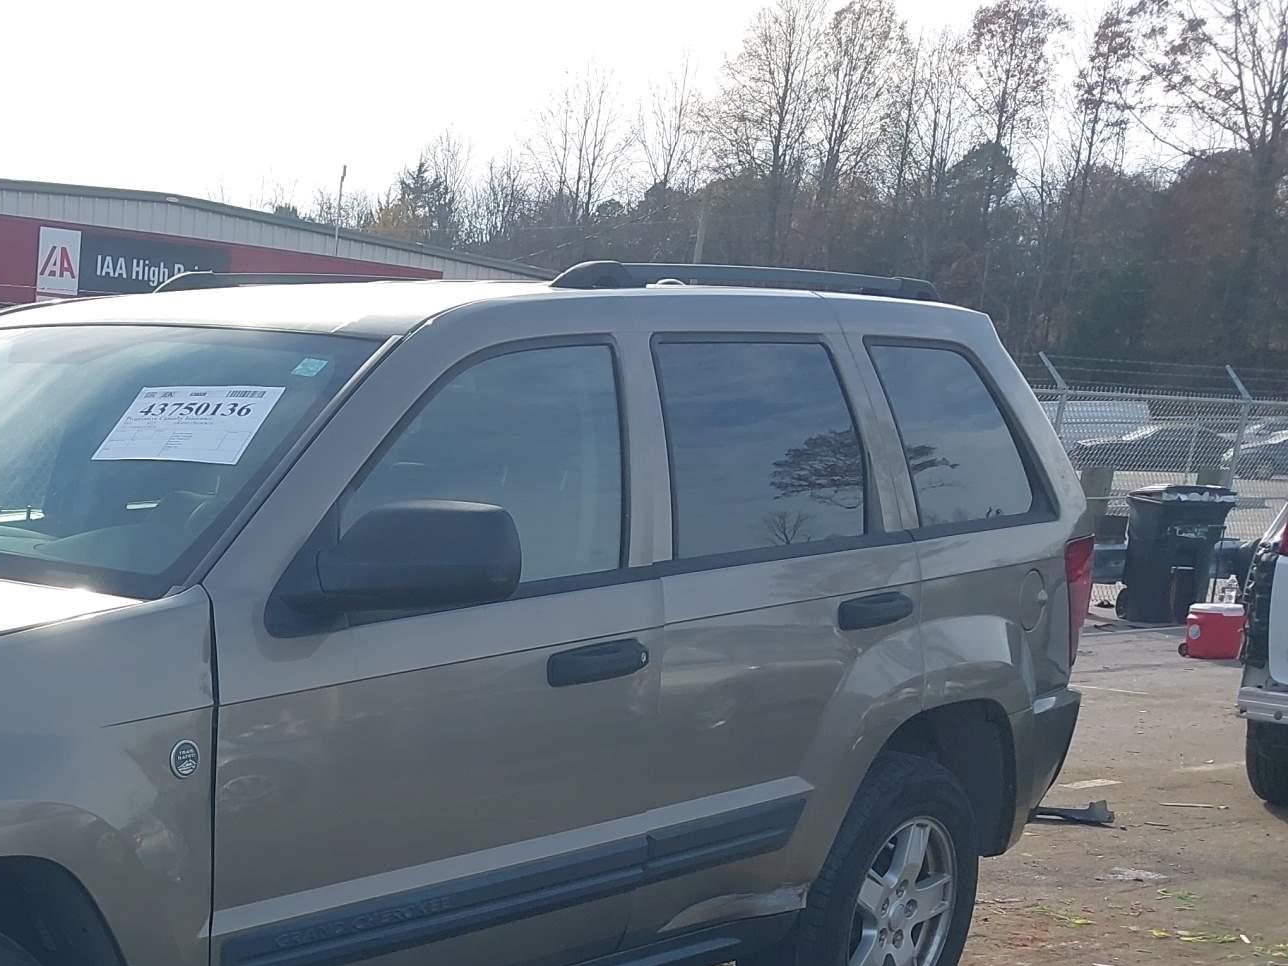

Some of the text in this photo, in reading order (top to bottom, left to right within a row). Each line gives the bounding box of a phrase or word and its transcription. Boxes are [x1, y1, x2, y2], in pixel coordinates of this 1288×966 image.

[96, 254, 127, 279] IAA
[131, 258, 169, 287] High
[140, 402, 255, 417] 43750136
